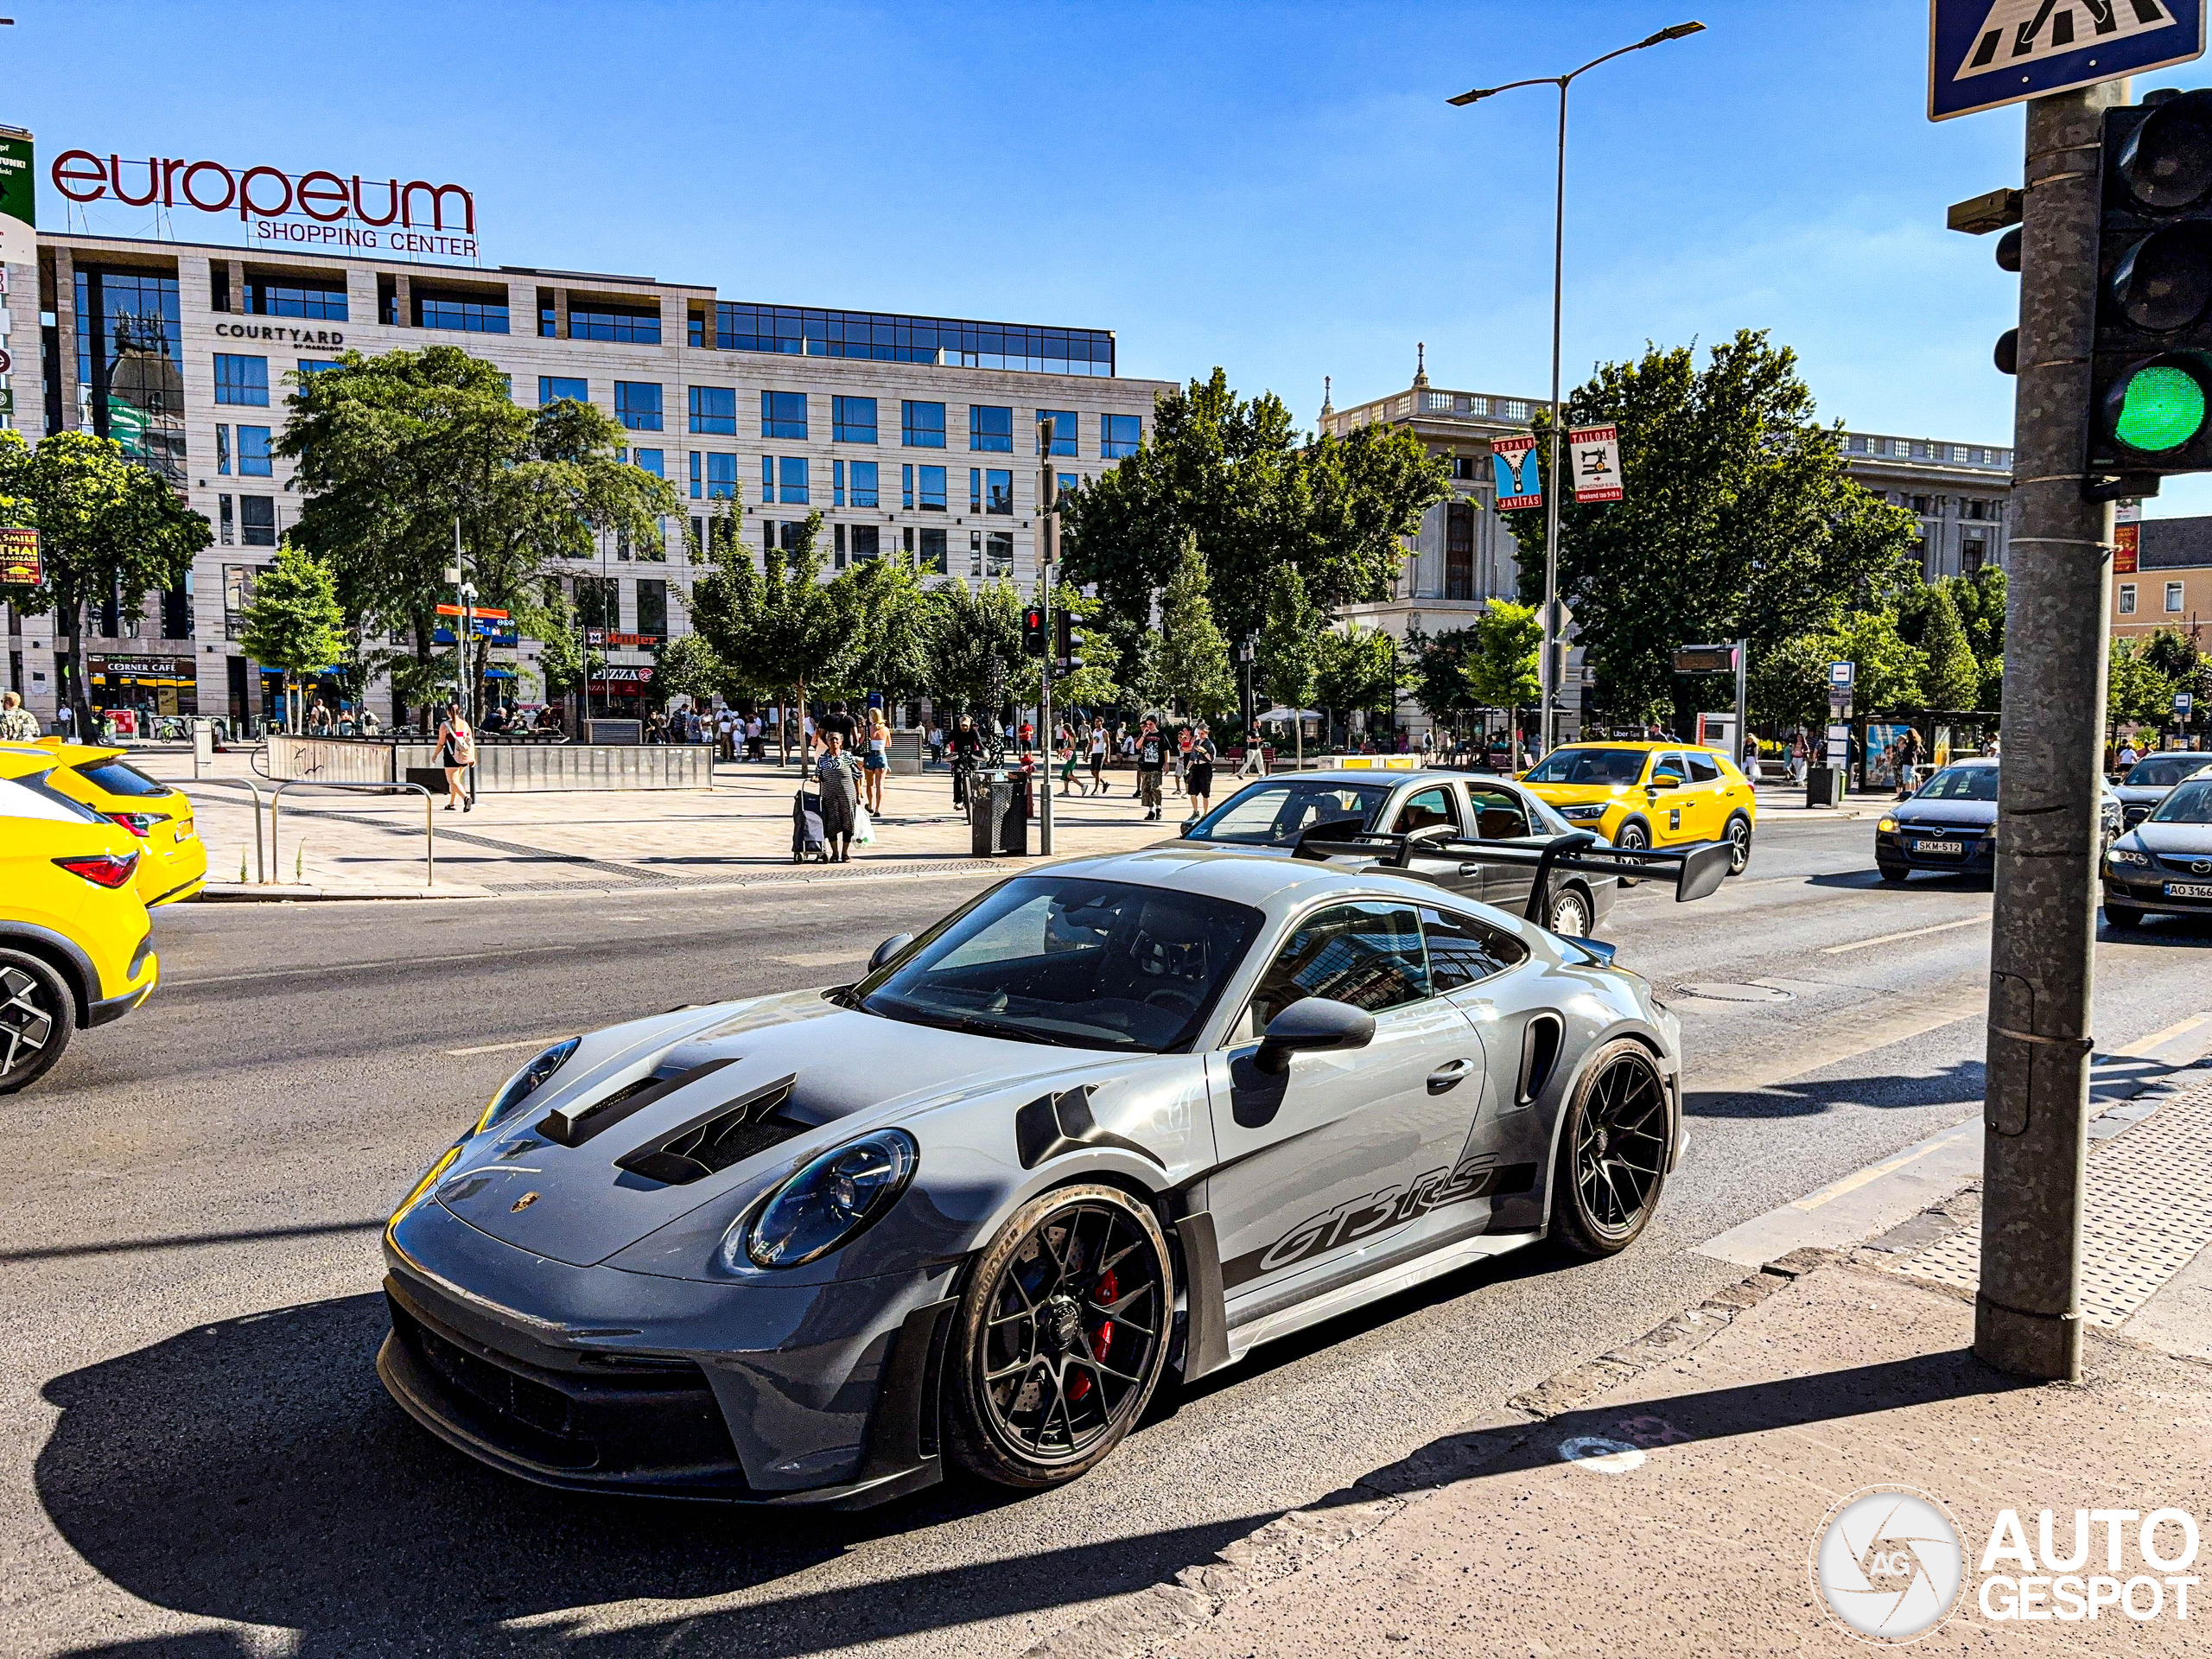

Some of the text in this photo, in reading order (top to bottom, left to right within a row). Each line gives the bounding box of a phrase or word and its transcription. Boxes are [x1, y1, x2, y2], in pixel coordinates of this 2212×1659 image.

[52, 149, 474, 234] europeum
[257, 221, 477, 257] SHOPPING CENTER
[216, 324, 344, 345] COURTYARD
[1572, 431, 1614, 443] TAILORS
[1494, 439, 1533, 452] REPAIR
[1501, 495, 1540, 508] JAVÍTÁS
[3, 533, 37, 543] SMILE
[0, 543, 38, 556] THAI
[107, 663, 149, 671] CORNER
[591, 669, 639, 681] PIZZA
[1919, 842, 1960, 852] SKM-512
[2171, 885, 2212, 897] AO 3166
